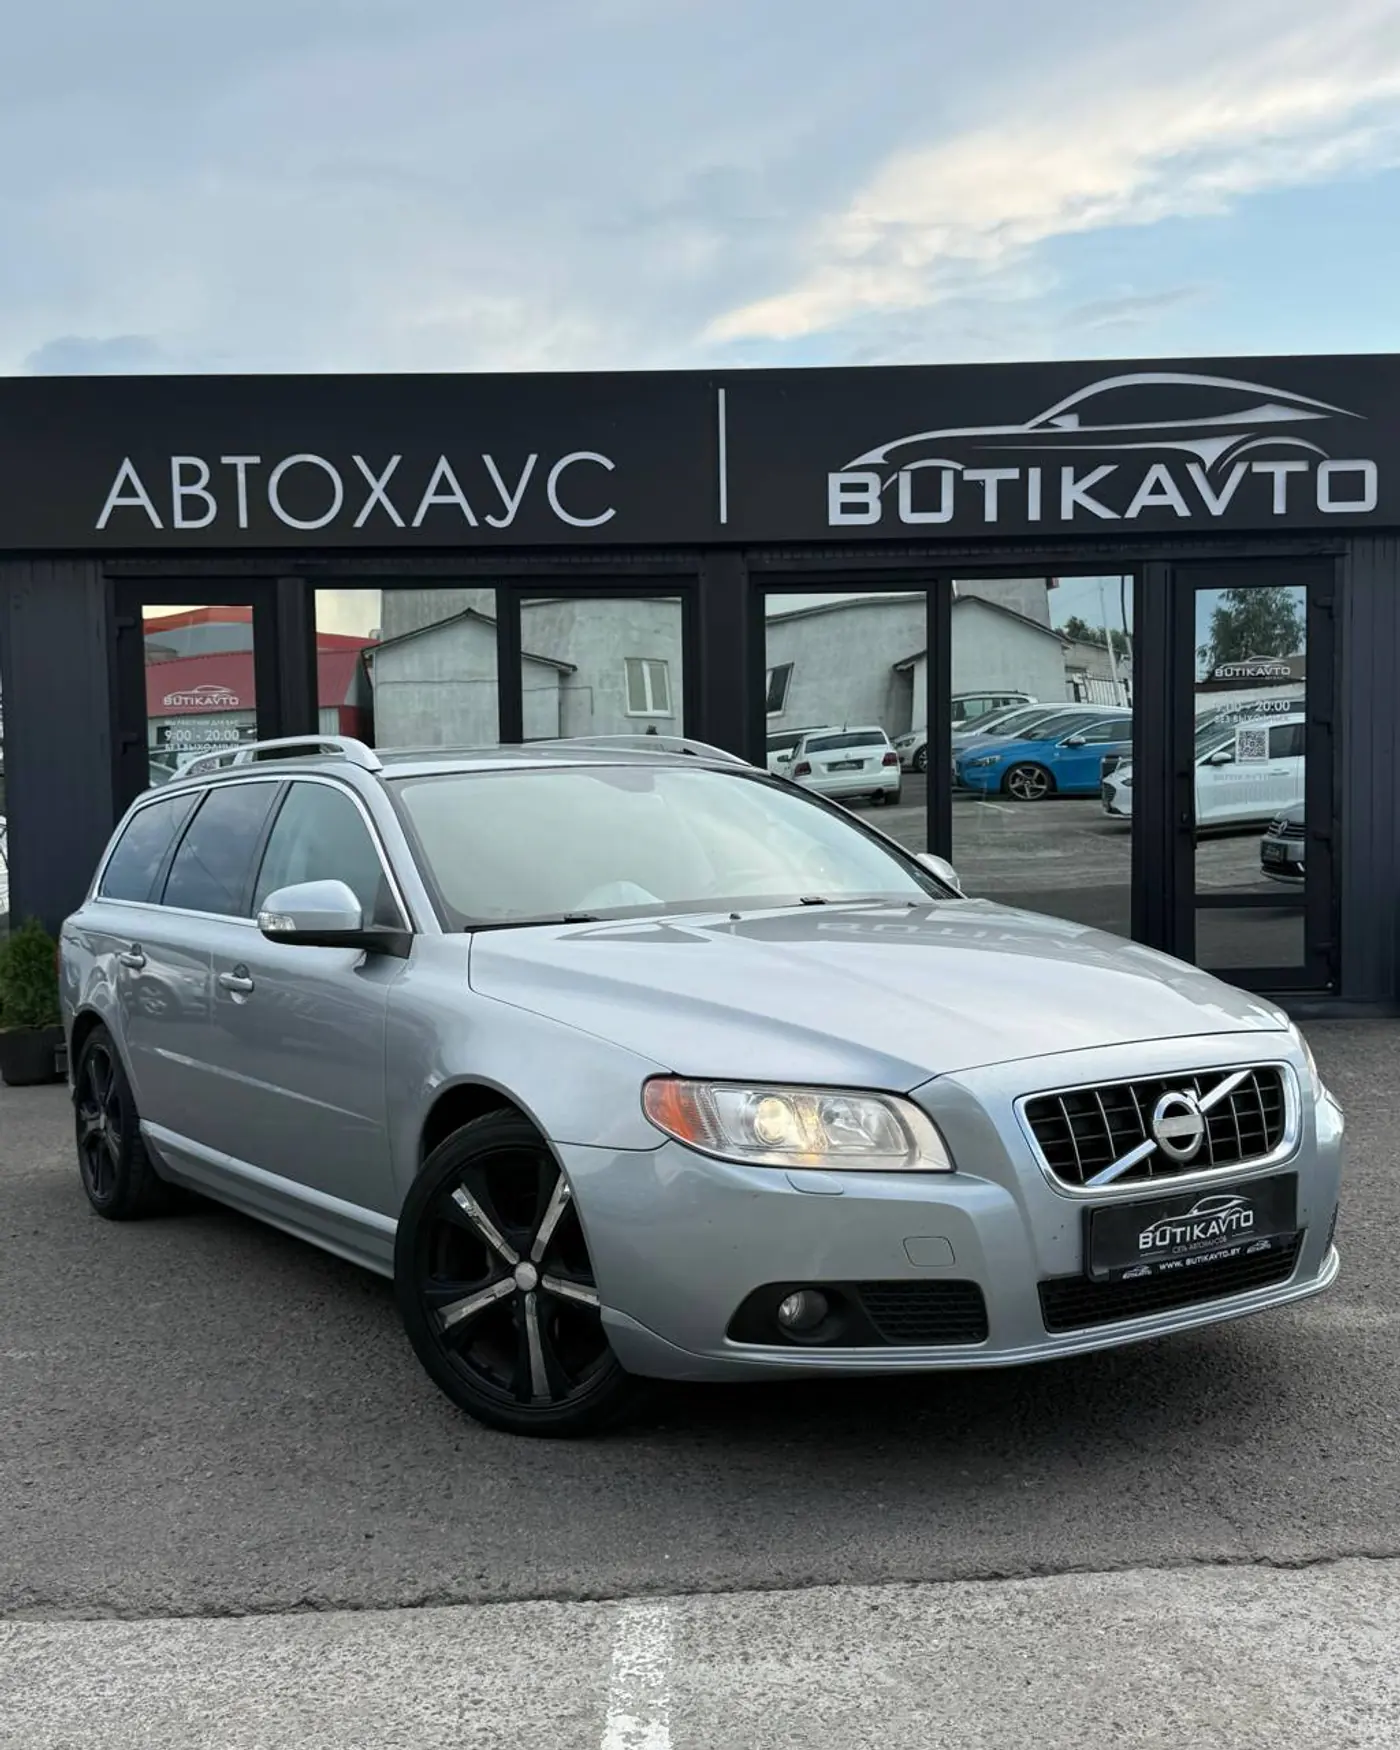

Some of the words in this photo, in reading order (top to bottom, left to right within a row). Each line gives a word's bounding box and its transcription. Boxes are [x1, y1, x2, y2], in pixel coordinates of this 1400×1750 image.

[95, 450, 617, 530] АВТОХАУС
[827, 457, 1379, 527] BUTIKAVTO
[1214, 666, 1291, 677] BUTIKAVTO
[163, 695, 240, 706] BUTIKAVTO
[1255, 700, 1291, 712] 20:00
[1138, 1210, 1254, 1250] BUTIKAVTO
